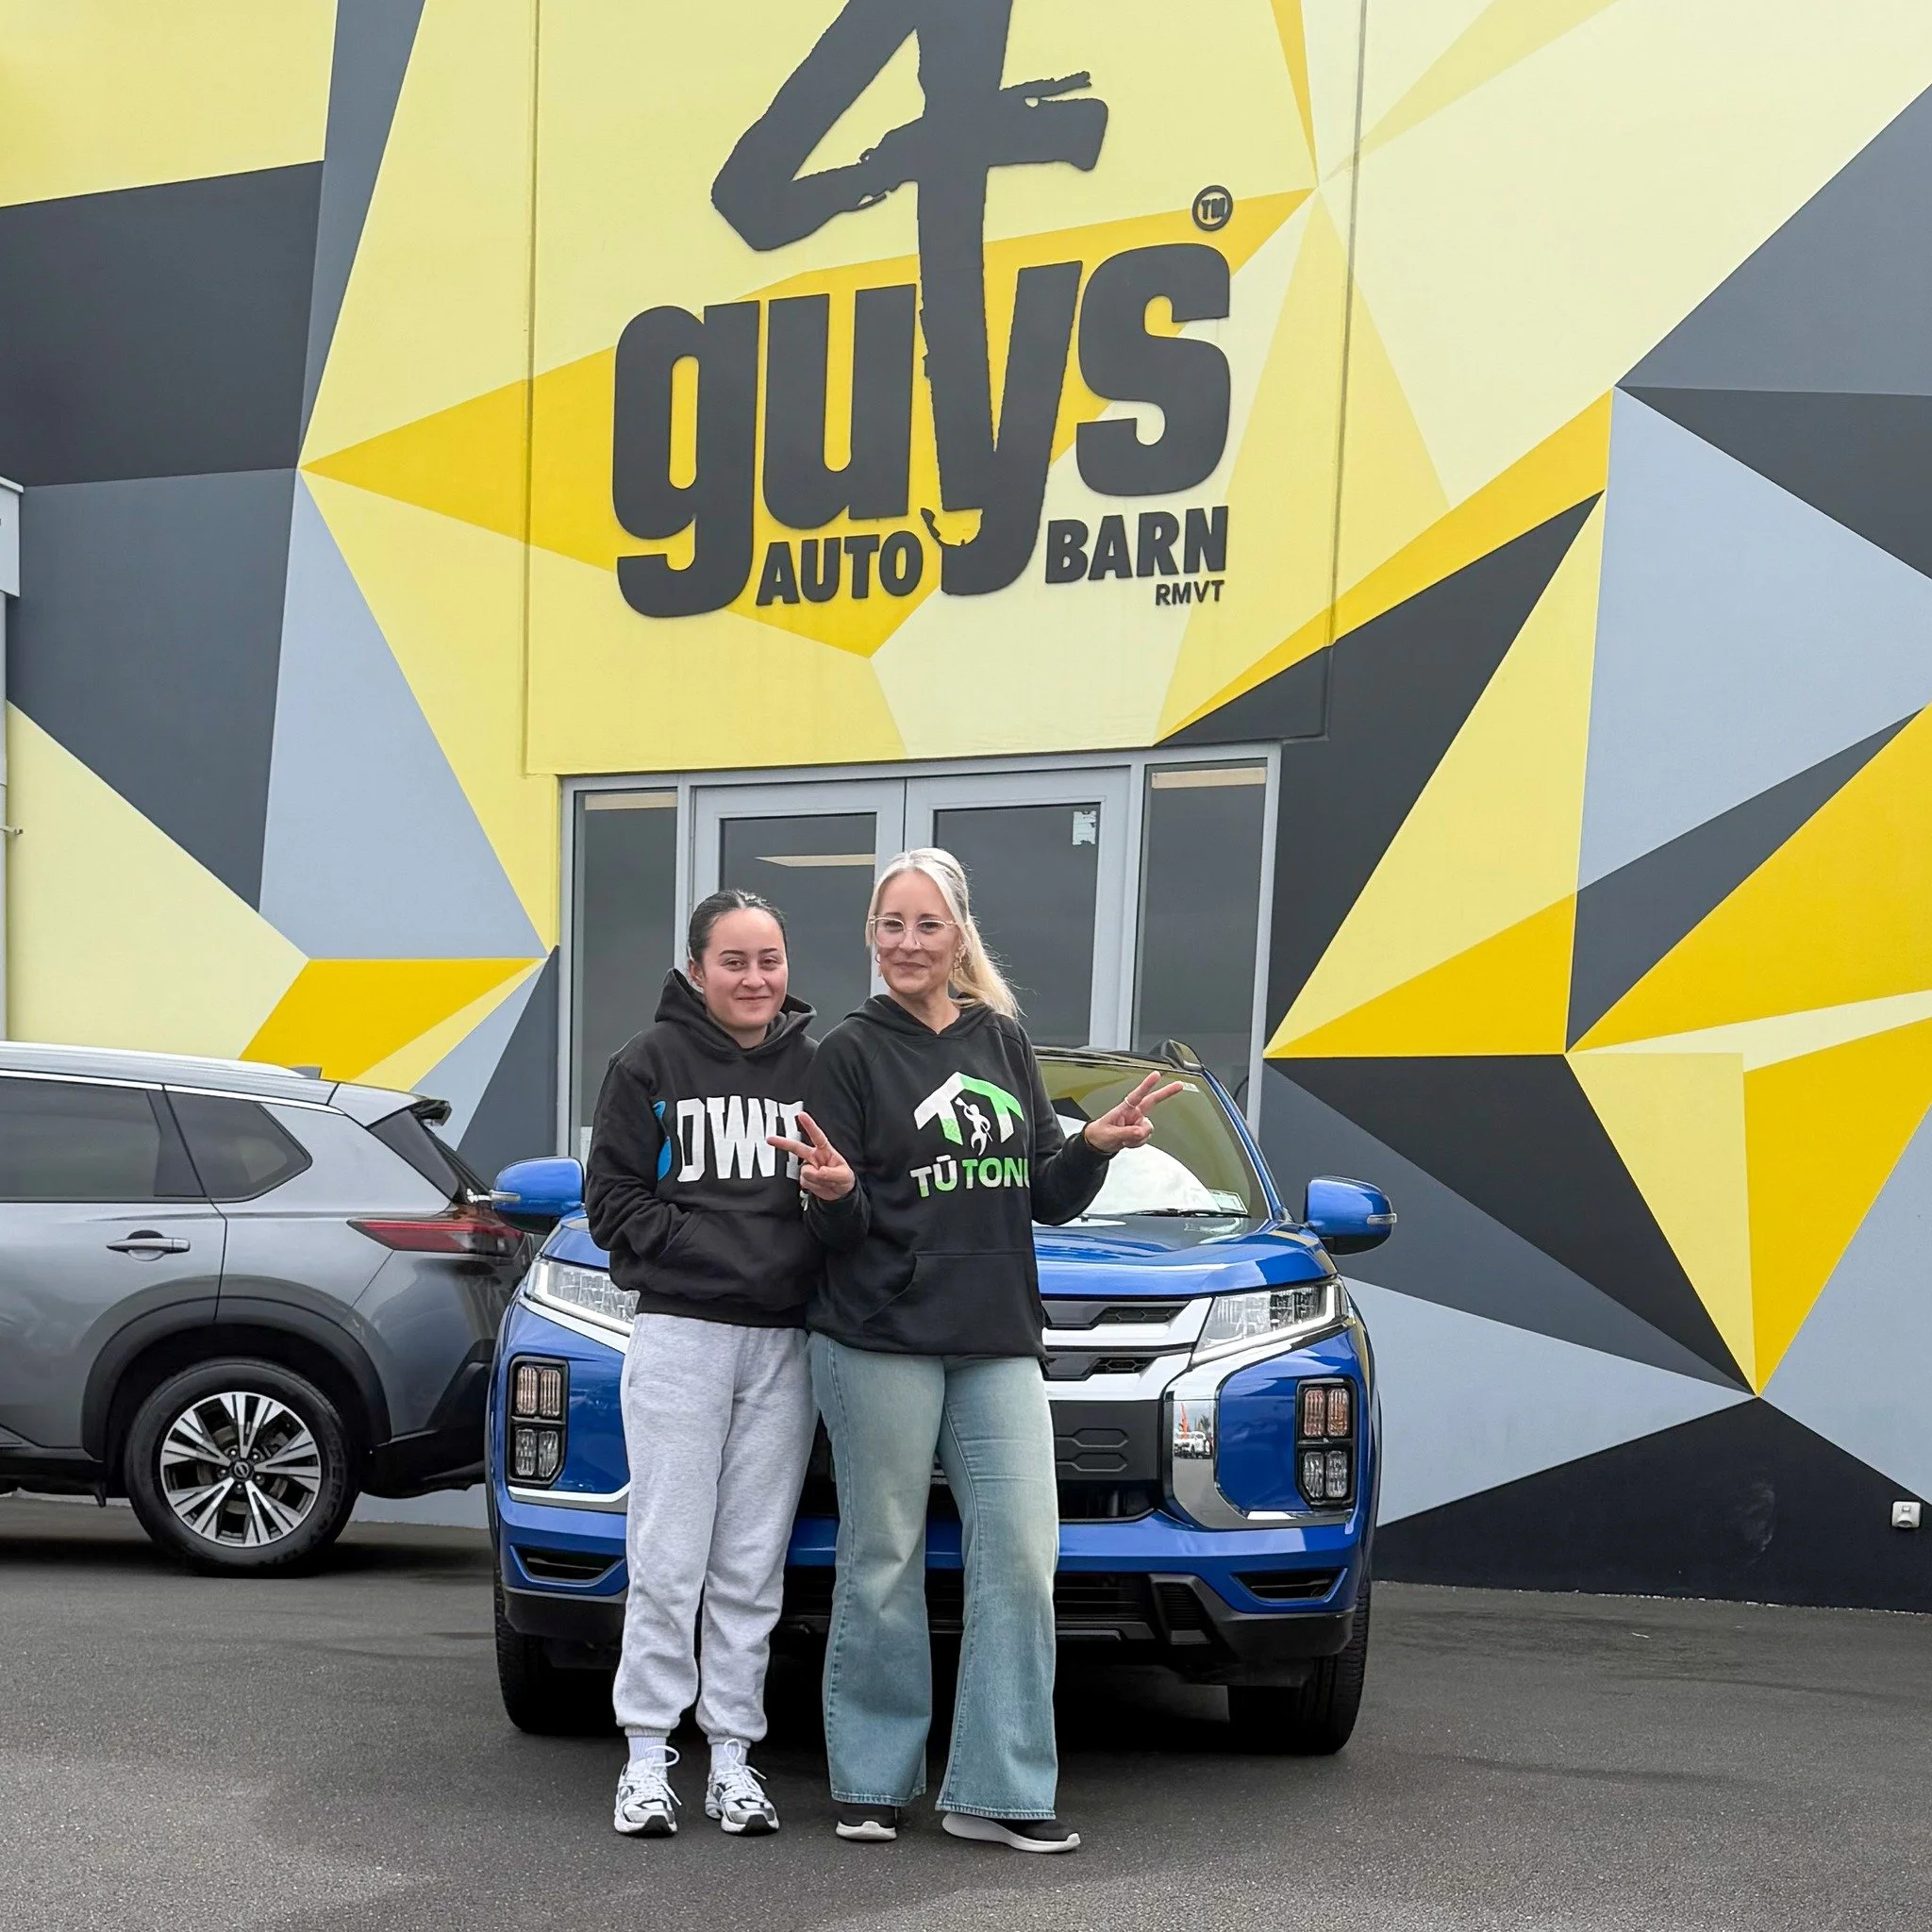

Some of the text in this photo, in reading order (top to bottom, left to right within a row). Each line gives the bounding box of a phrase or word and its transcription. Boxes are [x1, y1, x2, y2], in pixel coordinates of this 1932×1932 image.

[711, 0, 1109, 316] 4
[612, 242, 1231, 619] guys
[755, 505, 1229, 608] AUTO BARN
[1155, 579, 1225, 607] RMVT
[961, 1157, 1031, 1190] TON
